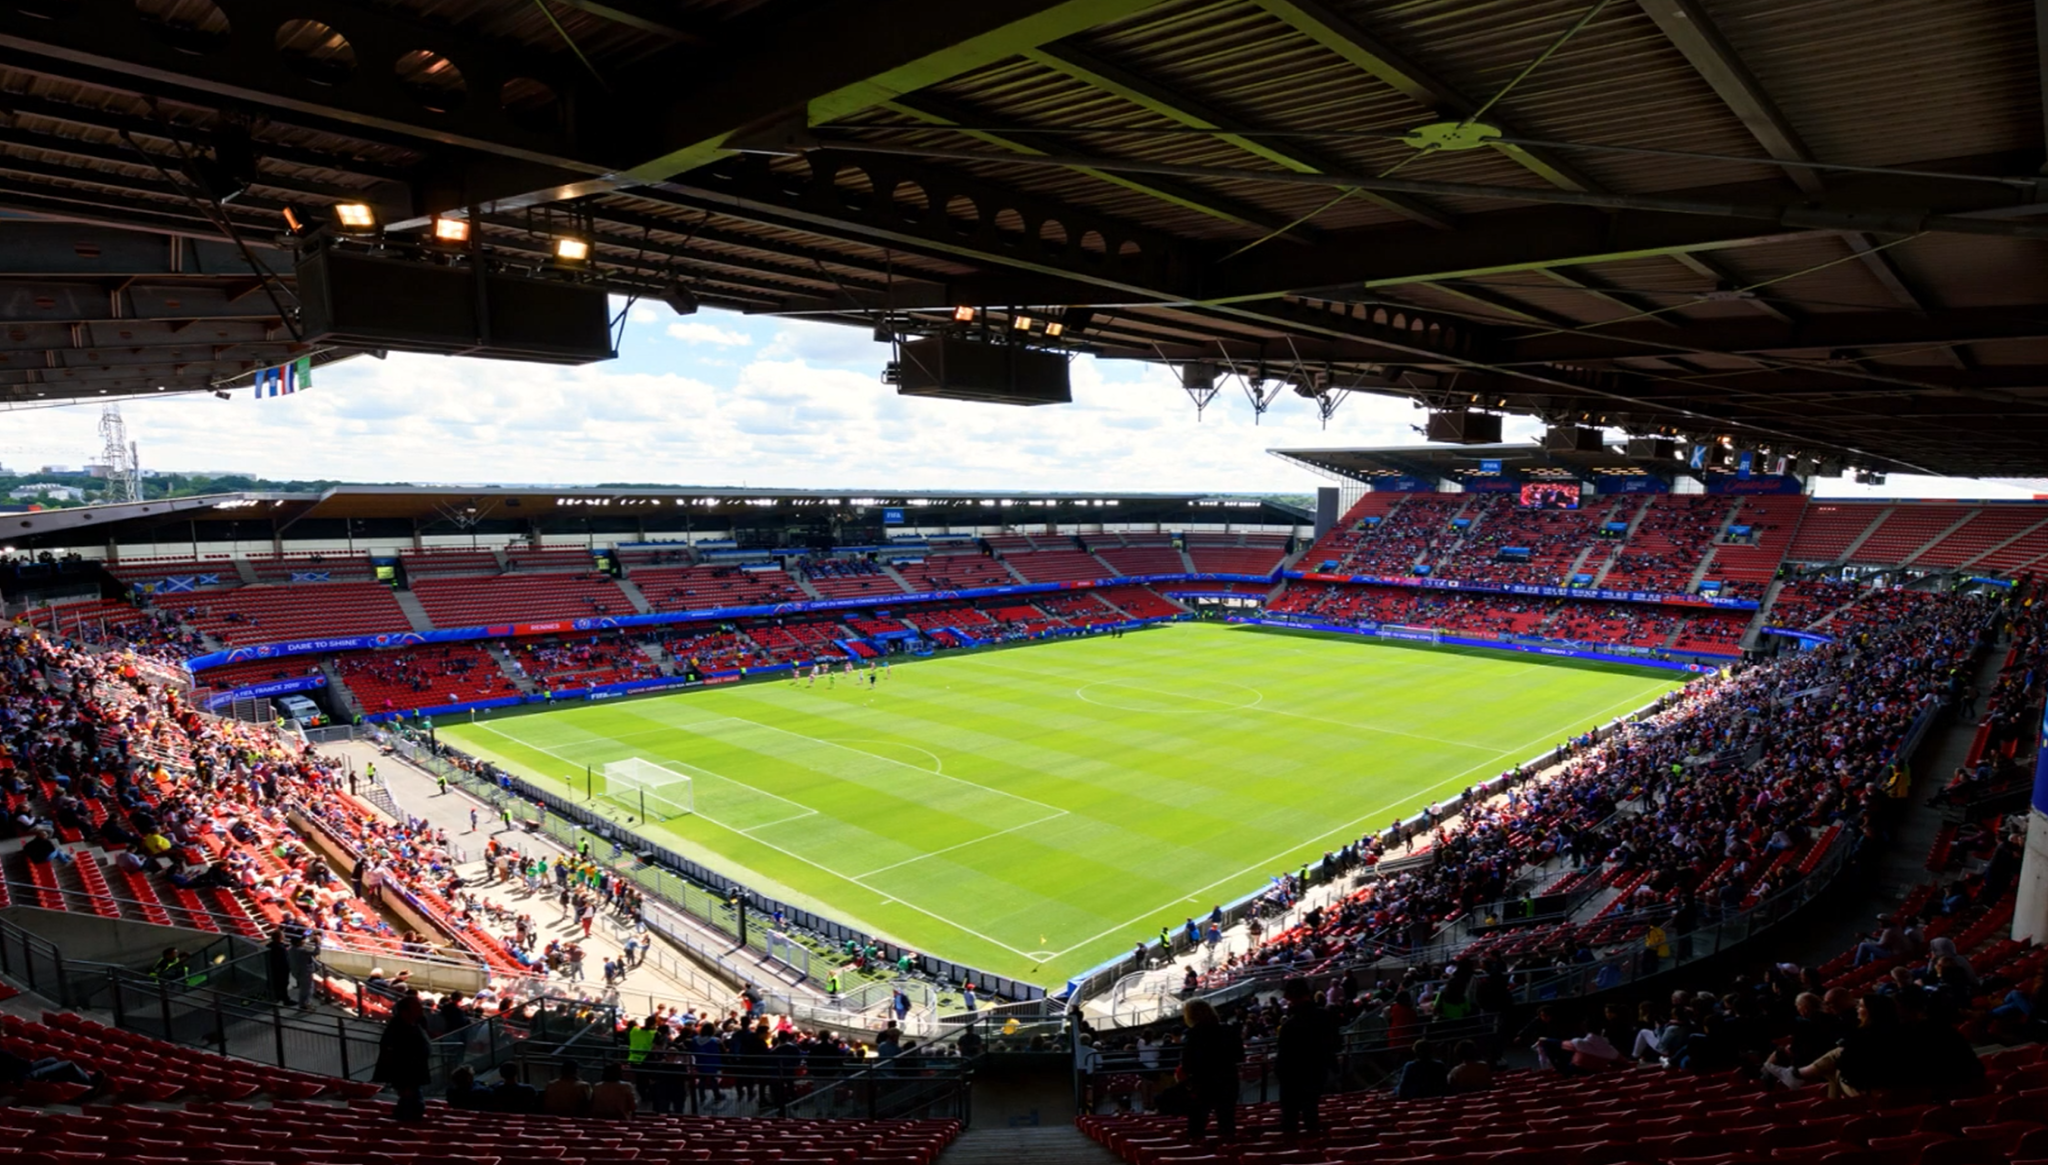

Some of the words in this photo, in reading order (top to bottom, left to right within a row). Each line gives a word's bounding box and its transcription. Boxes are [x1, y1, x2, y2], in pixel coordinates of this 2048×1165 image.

[886, 511, 902, 519] FIFA
[530, 623, 560, 631] RENNES
[287, 643, 313, 651] DARE
[328, 639, 358, 647] SHINE
[255, 685, 282, 695] FRANCE
[283, 682, 299, 690] 2019
